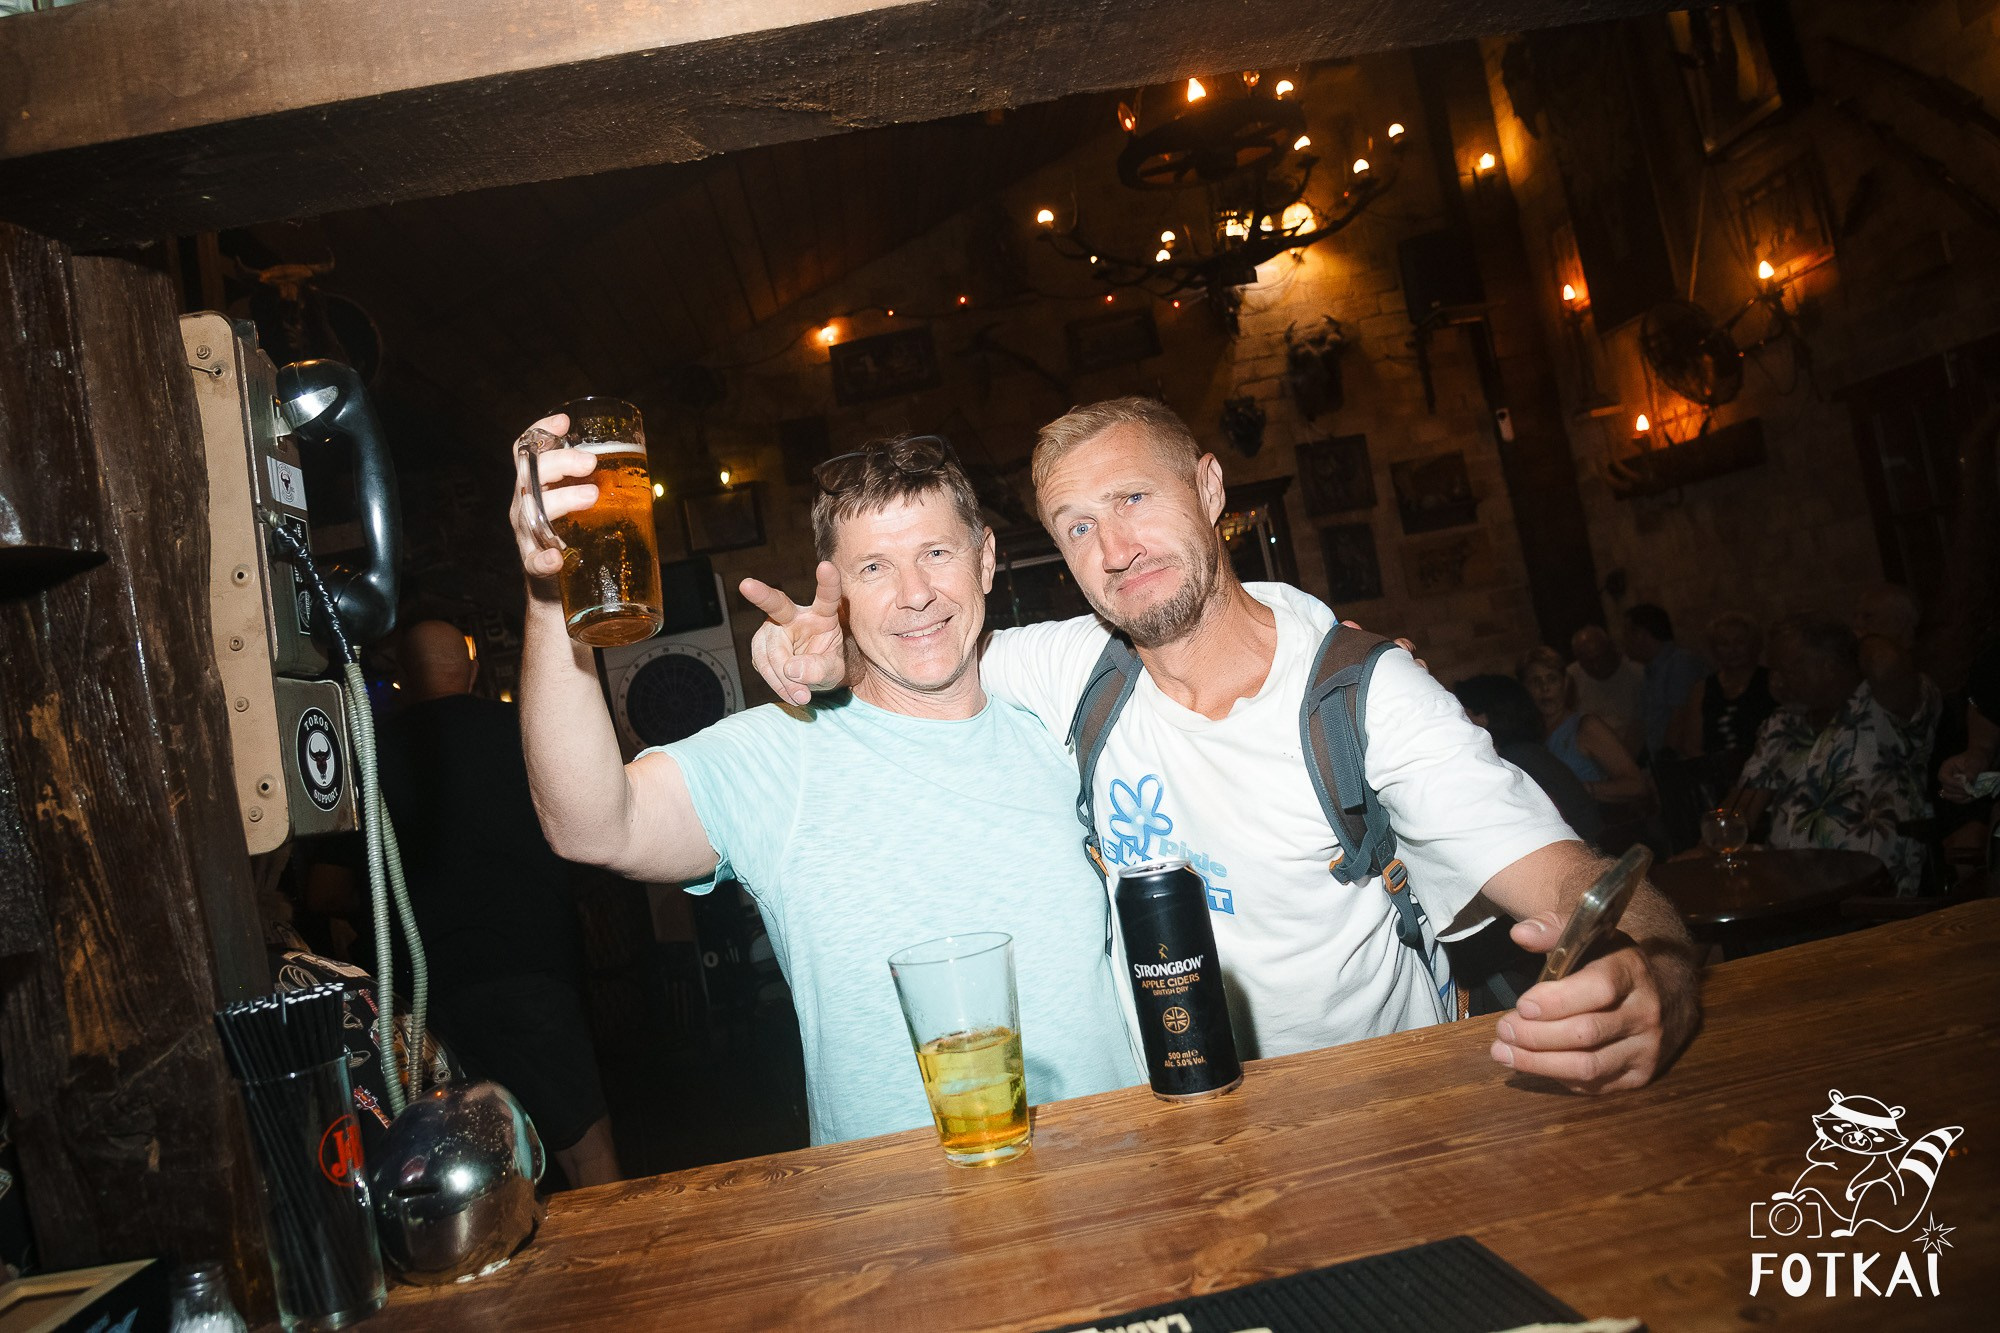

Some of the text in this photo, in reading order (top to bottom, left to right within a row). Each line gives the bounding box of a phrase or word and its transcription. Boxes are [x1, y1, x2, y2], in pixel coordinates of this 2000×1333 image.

[304, 714, 329, 732] TOROS
[313, 787, 339, 804] SUPPORT
[1158, 838, 1228, 878] pixie
[1133, 955, 1202, 979] STRONGBOW
[1141, 972, 1200, 989] APPLE CIDERS
[1153, 985, 1189, 996] BRITISH DRY
[1168, 1051, 1181, 1060] 500
[1176, 1059, 1193, 1067] 5.0%
